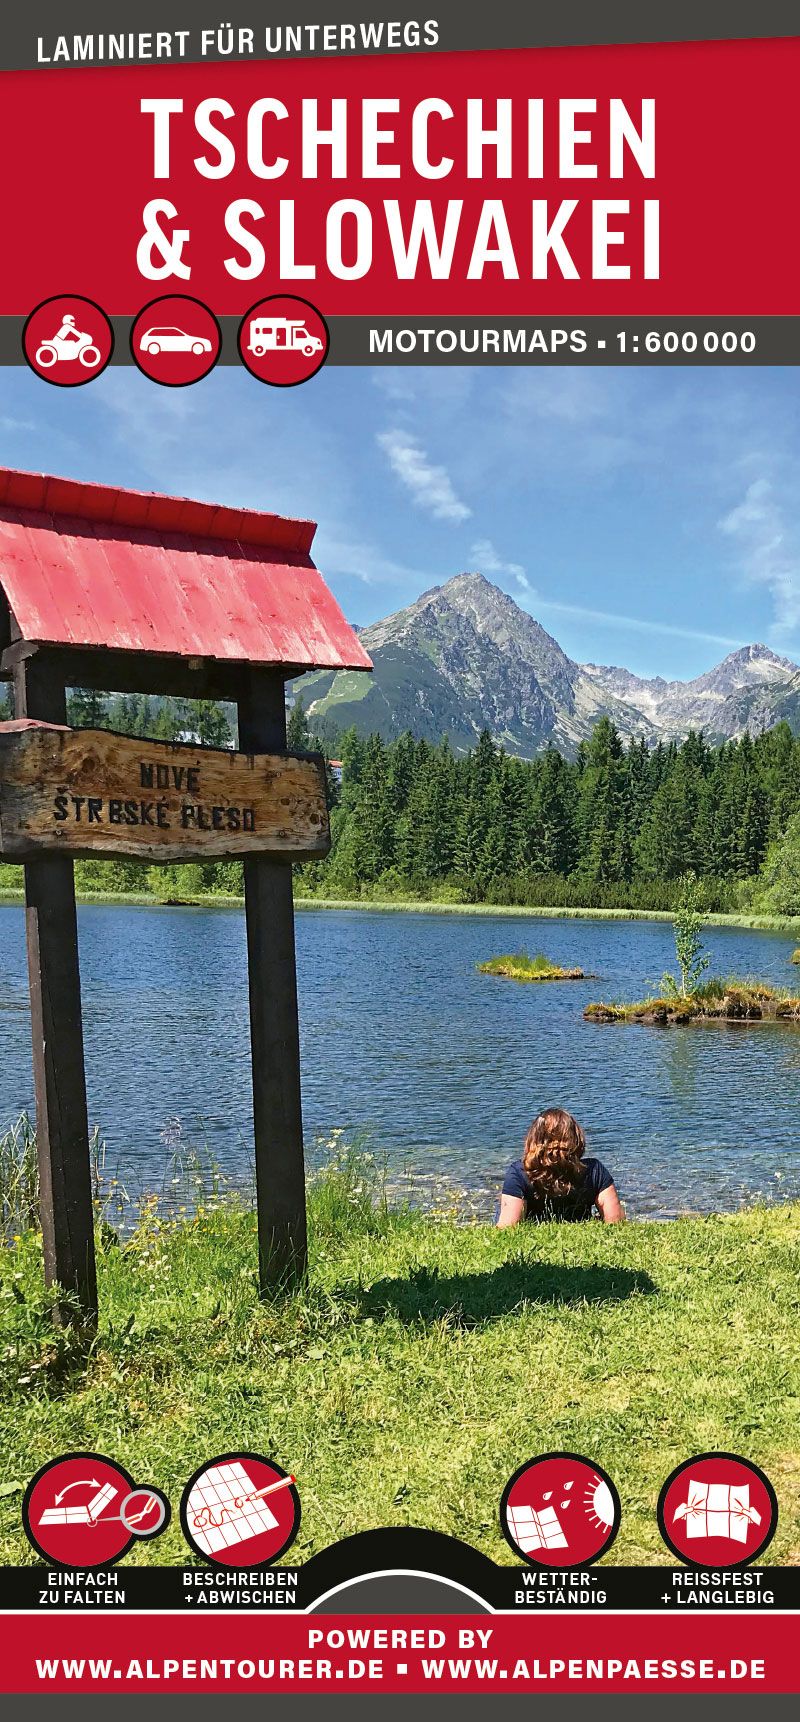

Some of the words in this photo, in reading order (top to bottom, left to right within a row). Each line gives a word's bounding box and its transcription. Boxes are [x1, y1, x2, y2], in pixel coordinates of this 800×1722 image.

[37, 31, 190, 63] LAMINIERT
[201, 22, 254, 56] FÜR
[265, 19, 440, 53] UNTERWEGS
[140, 97, 657, 180] TSCHECHIEN
[136, 198, 192, 281] &
[223, 198, 660, 281] SLOWAKEI
[369, 329, 588, 353] MOTOURMAPS
[180, 804, 256, 832] PLESO
[47, 1572, 119, 1586] EINFACH
[183, 1572, 299, 1586] BESCHREIBEN
[521, 1572, 598, 1586] WETTER-
[672, 1572, 764, 1586] REISSFEST
[39, 1590, 59, 1604] ZU
[64, 1590, 126, 1604] FALTEN
[184, 1593, 193, 1603] +
[196, 1590, 297, 1604] ABWISCHEN
[515, 1587, 607, 1604] BESTÄNDIG
[660, 1592, 672, 1604] +
[677, 1590, 775, 1604] LANGLEBIG
[308, 1629, 446, 1649] POWERED
[458, 1629, 494, 1649] BY
[35, 1659, 384, 1679] WWW.ALPENTOURER.DE
[421, 1659, 766, 1679] WWW.ALPENPAESSE.DE
